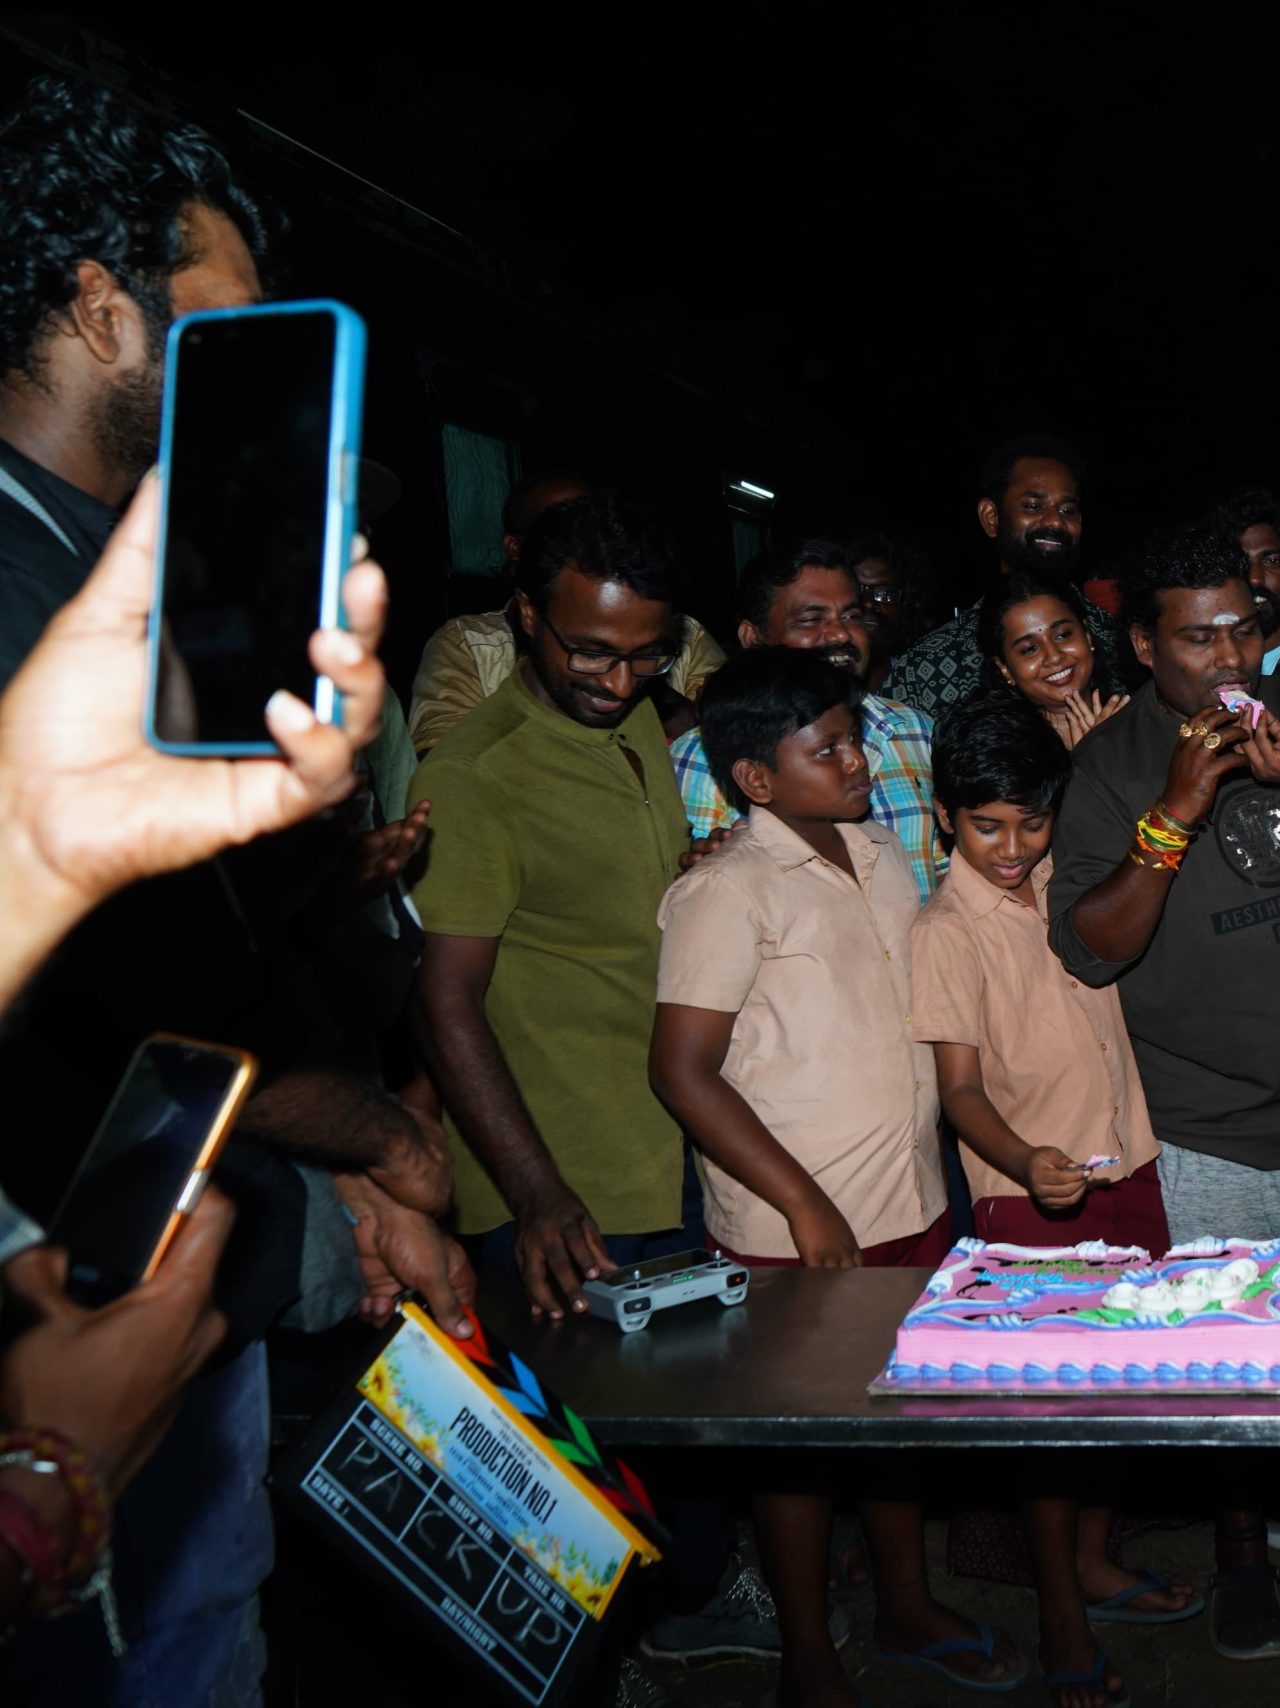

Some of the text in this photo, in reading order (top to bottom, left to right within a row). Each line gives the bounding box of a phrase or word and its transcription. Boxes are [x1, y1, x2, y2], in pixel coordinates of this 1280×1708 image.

[369, 1417, 423, 1475] SCENE NO.
[449, 1405, 533, 1499] PRODUCTION
[523, 1480, 557, 1525] NO.1
[309, 1474, 346, 1510] DATE
[448, 1493, 479, 1527] SHOT
[475, 1520, 494, 1545] NO.
[496, 1577, 562, 1645] UP
[524, 1564, 567, 1615] TAKE NO.
[439, 1595, 498, 1653] DAY/NIGHT
